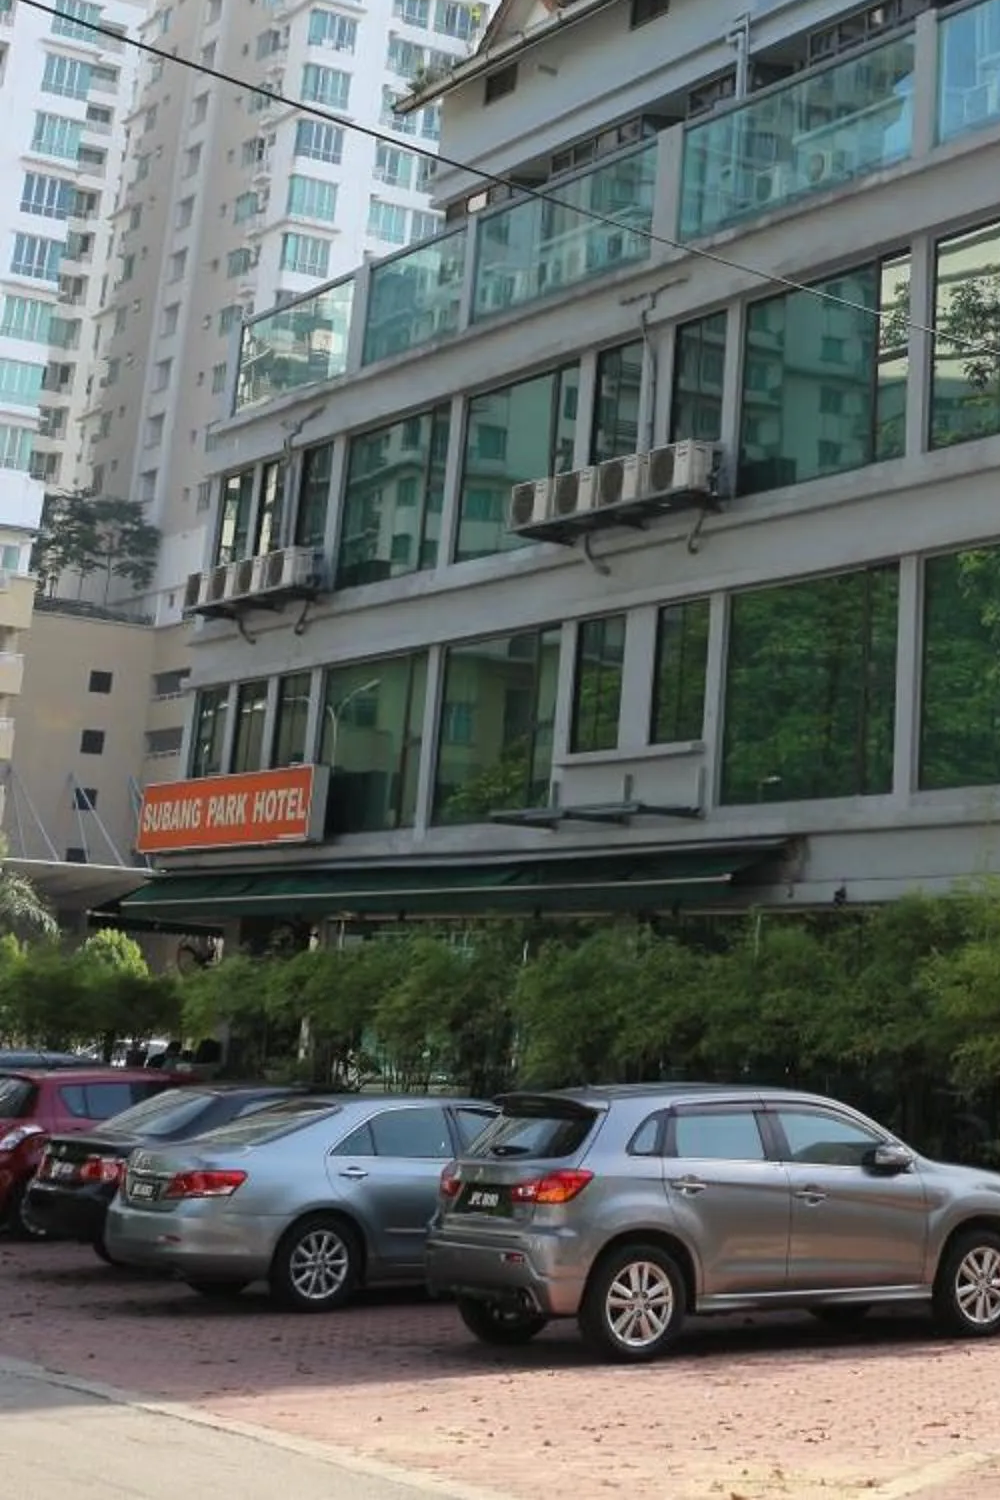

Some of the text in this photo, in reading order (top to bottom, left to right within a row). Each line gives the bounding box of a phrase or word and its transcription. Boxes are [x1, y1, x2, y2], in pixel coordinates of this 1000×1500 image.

[143, 787, 306, 832] SUBANG PARK HOTEL
